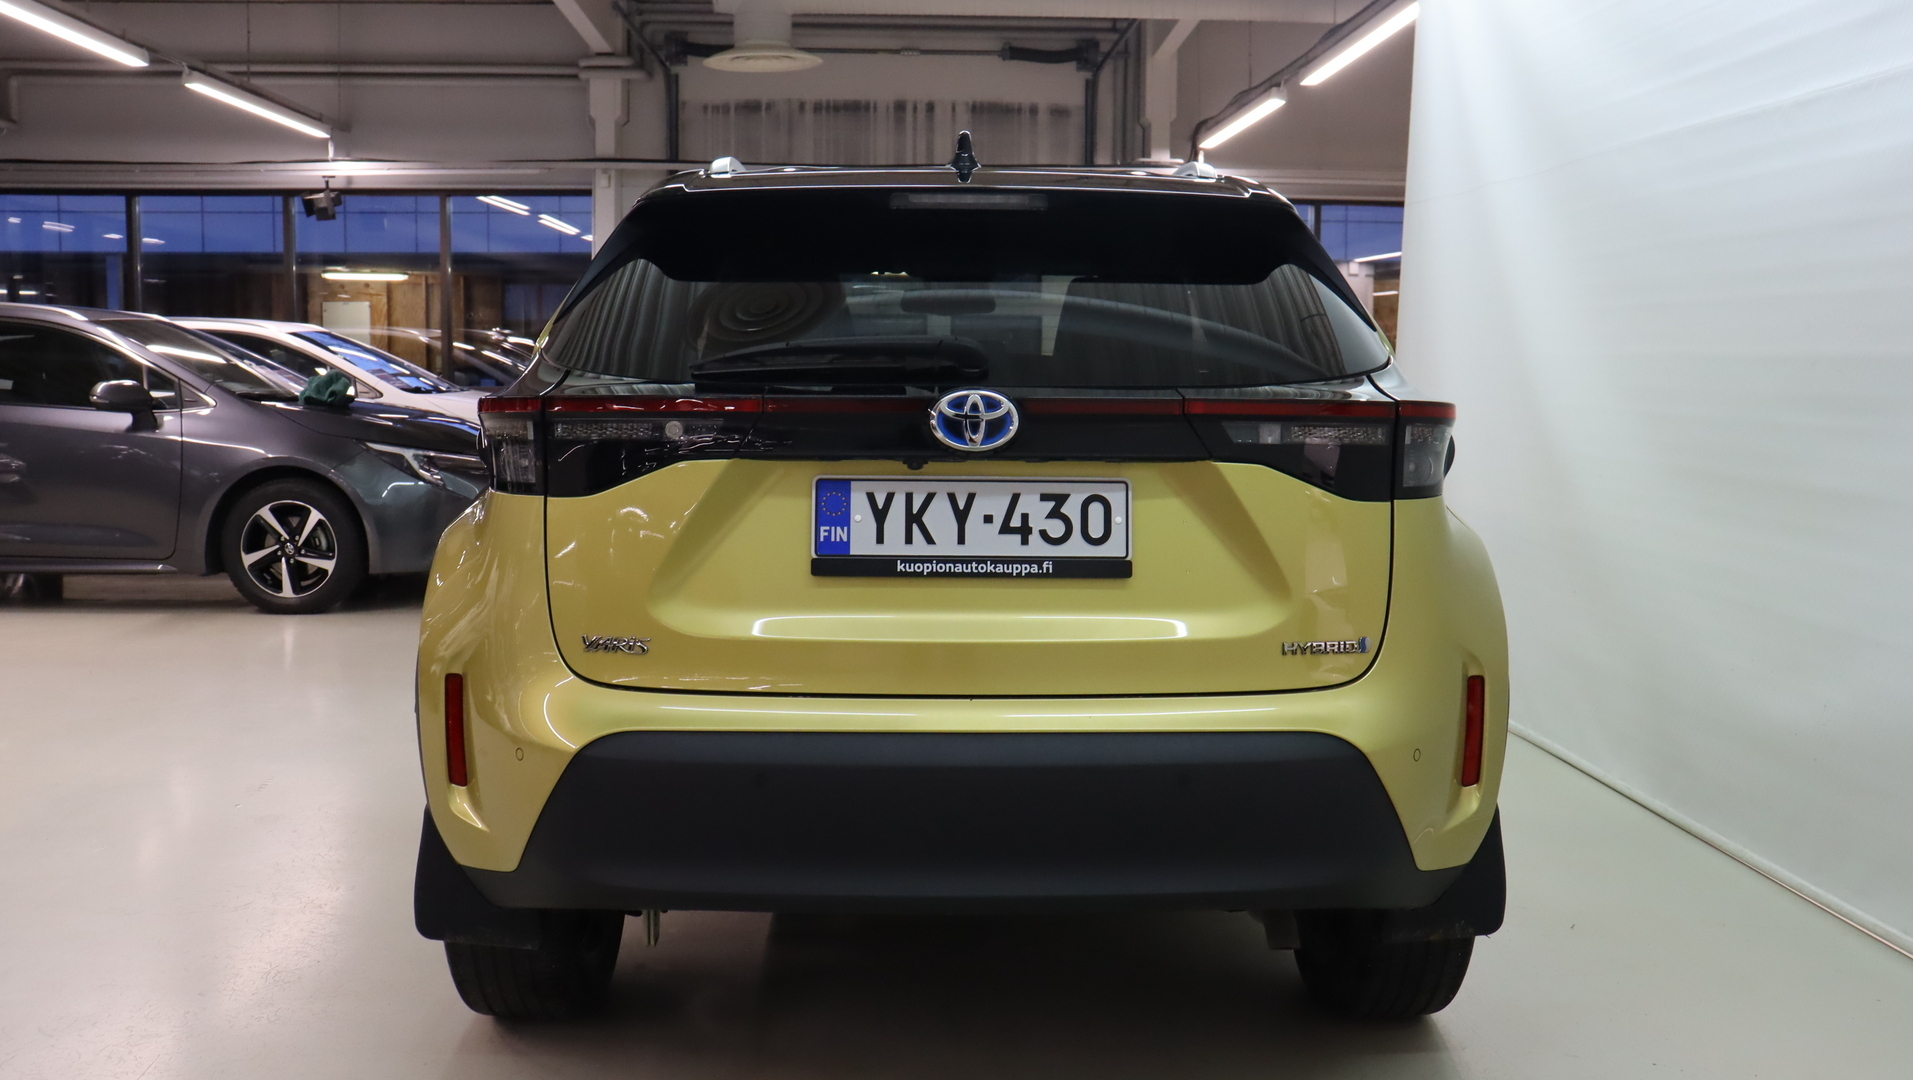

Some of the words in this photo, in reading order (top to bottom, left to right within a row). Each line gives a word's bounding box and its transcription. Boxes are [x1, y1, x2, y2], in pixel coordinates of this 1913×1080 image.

[820, 526, 848, 542] FIN
[897, 560, 1053, 576] kuopionautokauppa.fi
[1282, 640, 1361, 655] HYBRID
